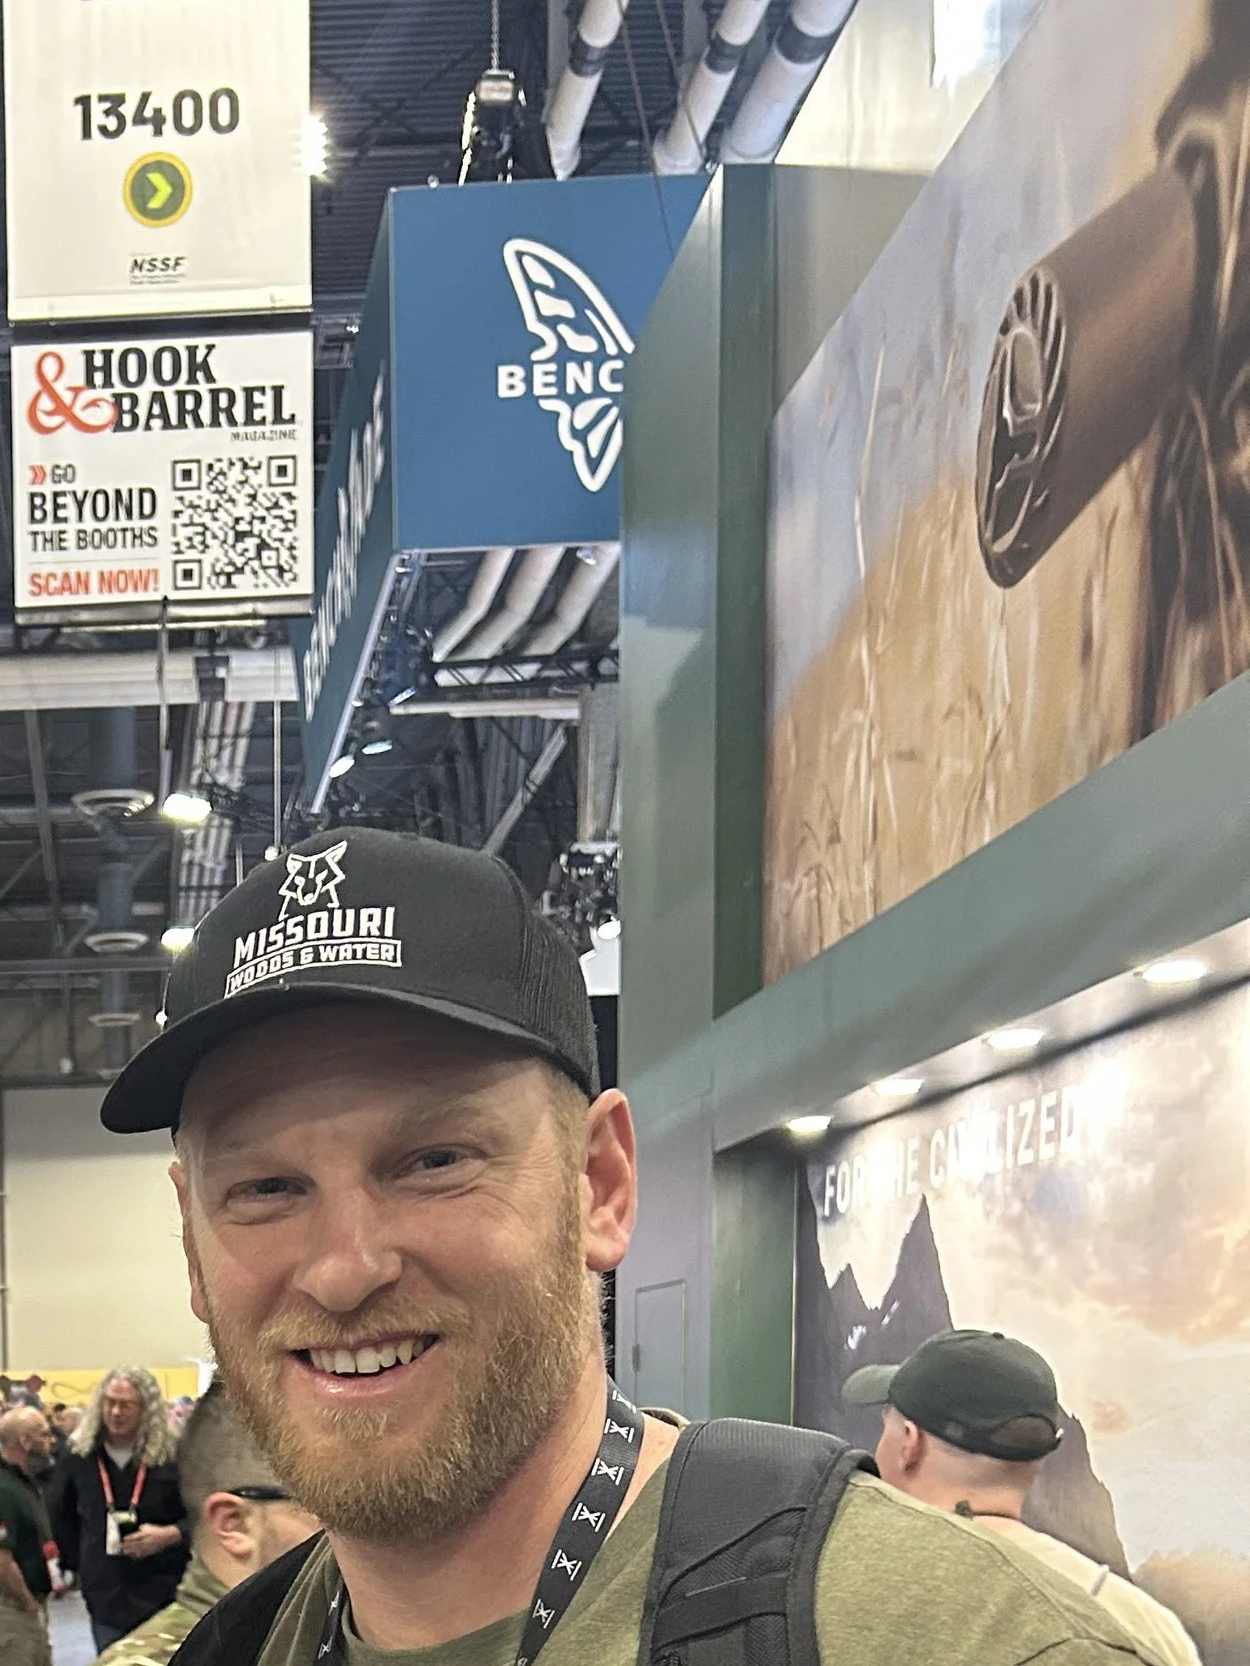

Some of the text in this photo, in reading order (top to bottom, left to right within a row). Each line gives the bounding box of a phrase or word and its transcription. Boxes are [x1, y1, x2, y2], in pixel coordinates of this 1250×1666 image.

[73, 86, 241, 141] 13400
[129, 255, 187, 273] NSSF
[81, 343, 217, 389] HOOK
[496, 359, 625, 398] BENC
[26, 351, 296, 435] & BARREL
[50, 463, 76, 484] GO
[28, 487, 157, 524] BEYOND
[29, 526, 158, 552] THE BOOTHS
[28, 567, 160, 597] SCAN NOW!
[233, 906, 396, 969] MISSOURI
[230, 943, 395, 993] WOODS & WATER
[822, 1154, 868, 1218] FOR
